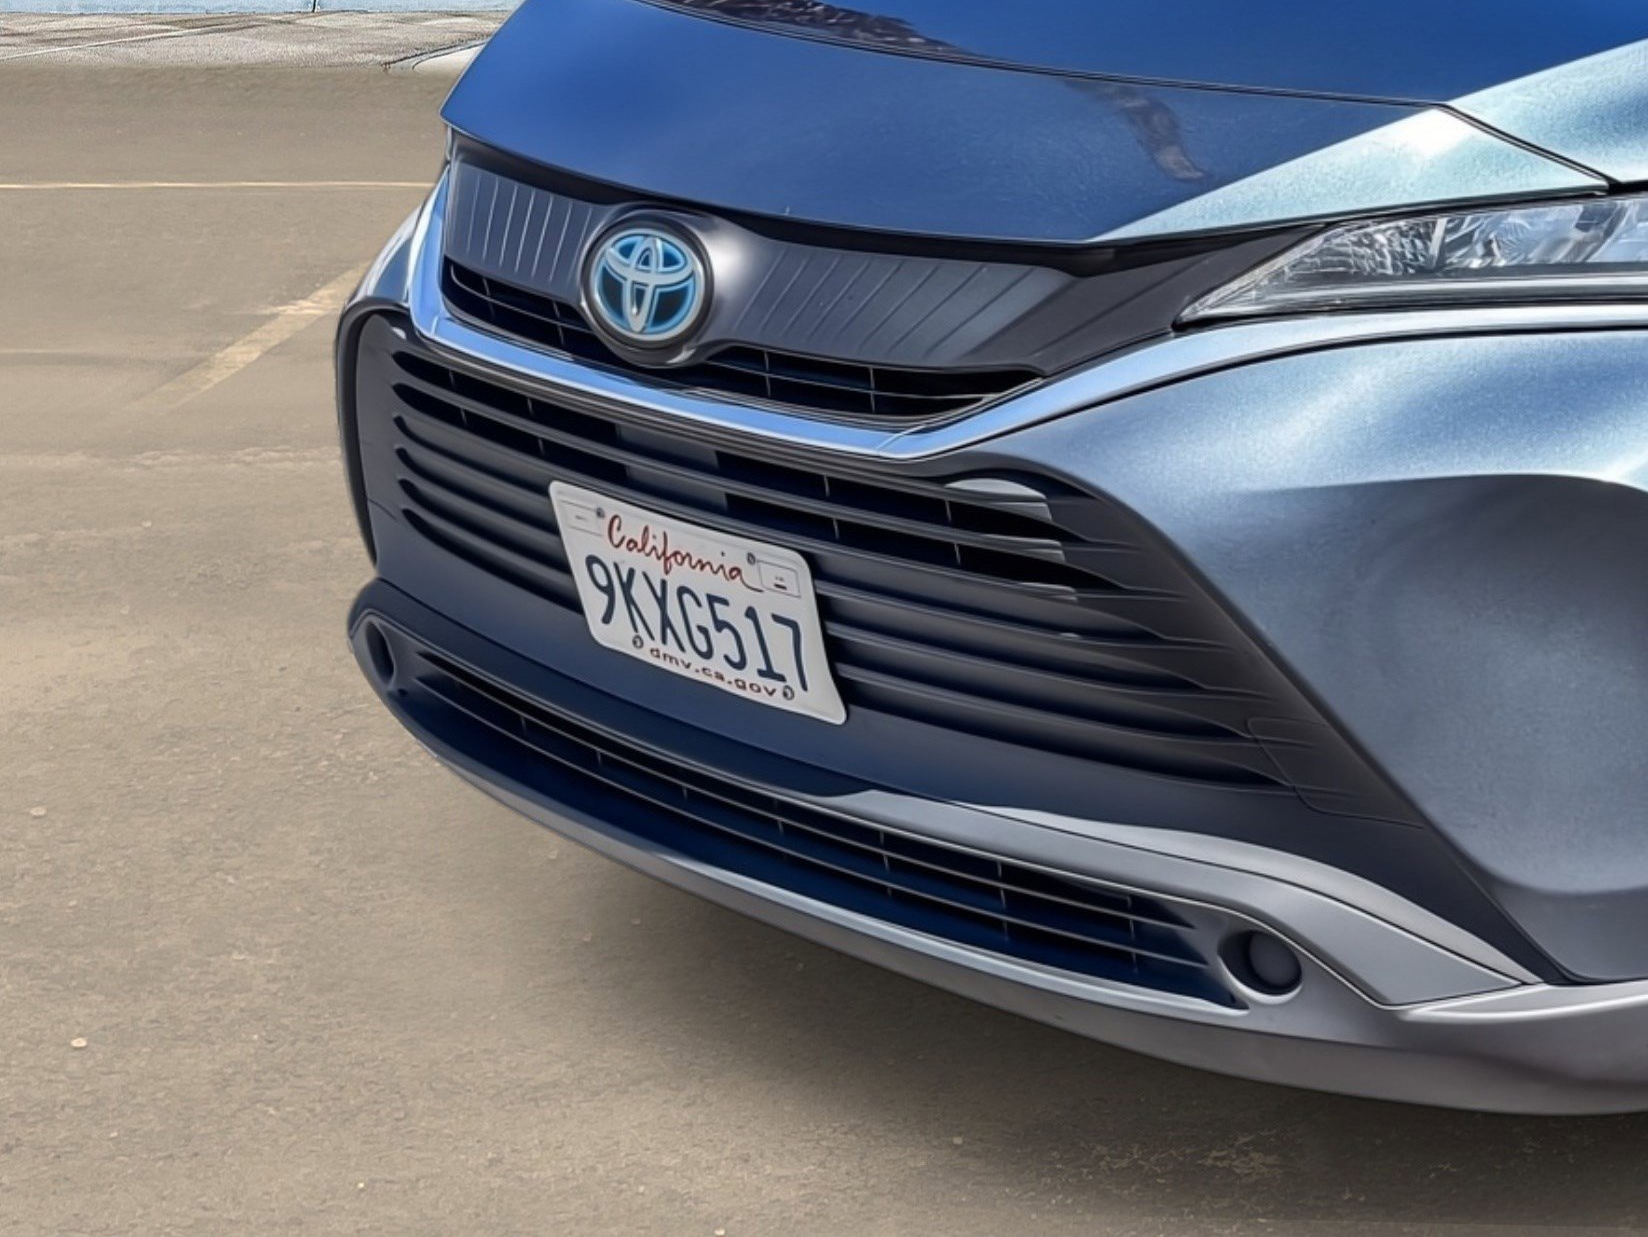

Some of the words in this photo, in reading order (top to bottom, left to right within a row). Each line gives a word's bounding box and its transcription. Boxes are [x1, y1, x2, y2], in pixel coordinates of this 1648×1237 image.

[607, 514, 765, 593] California
[585, 554, 808, 692] 9KXG517
[650, 647, 778, 698] dmv.ca.gov
